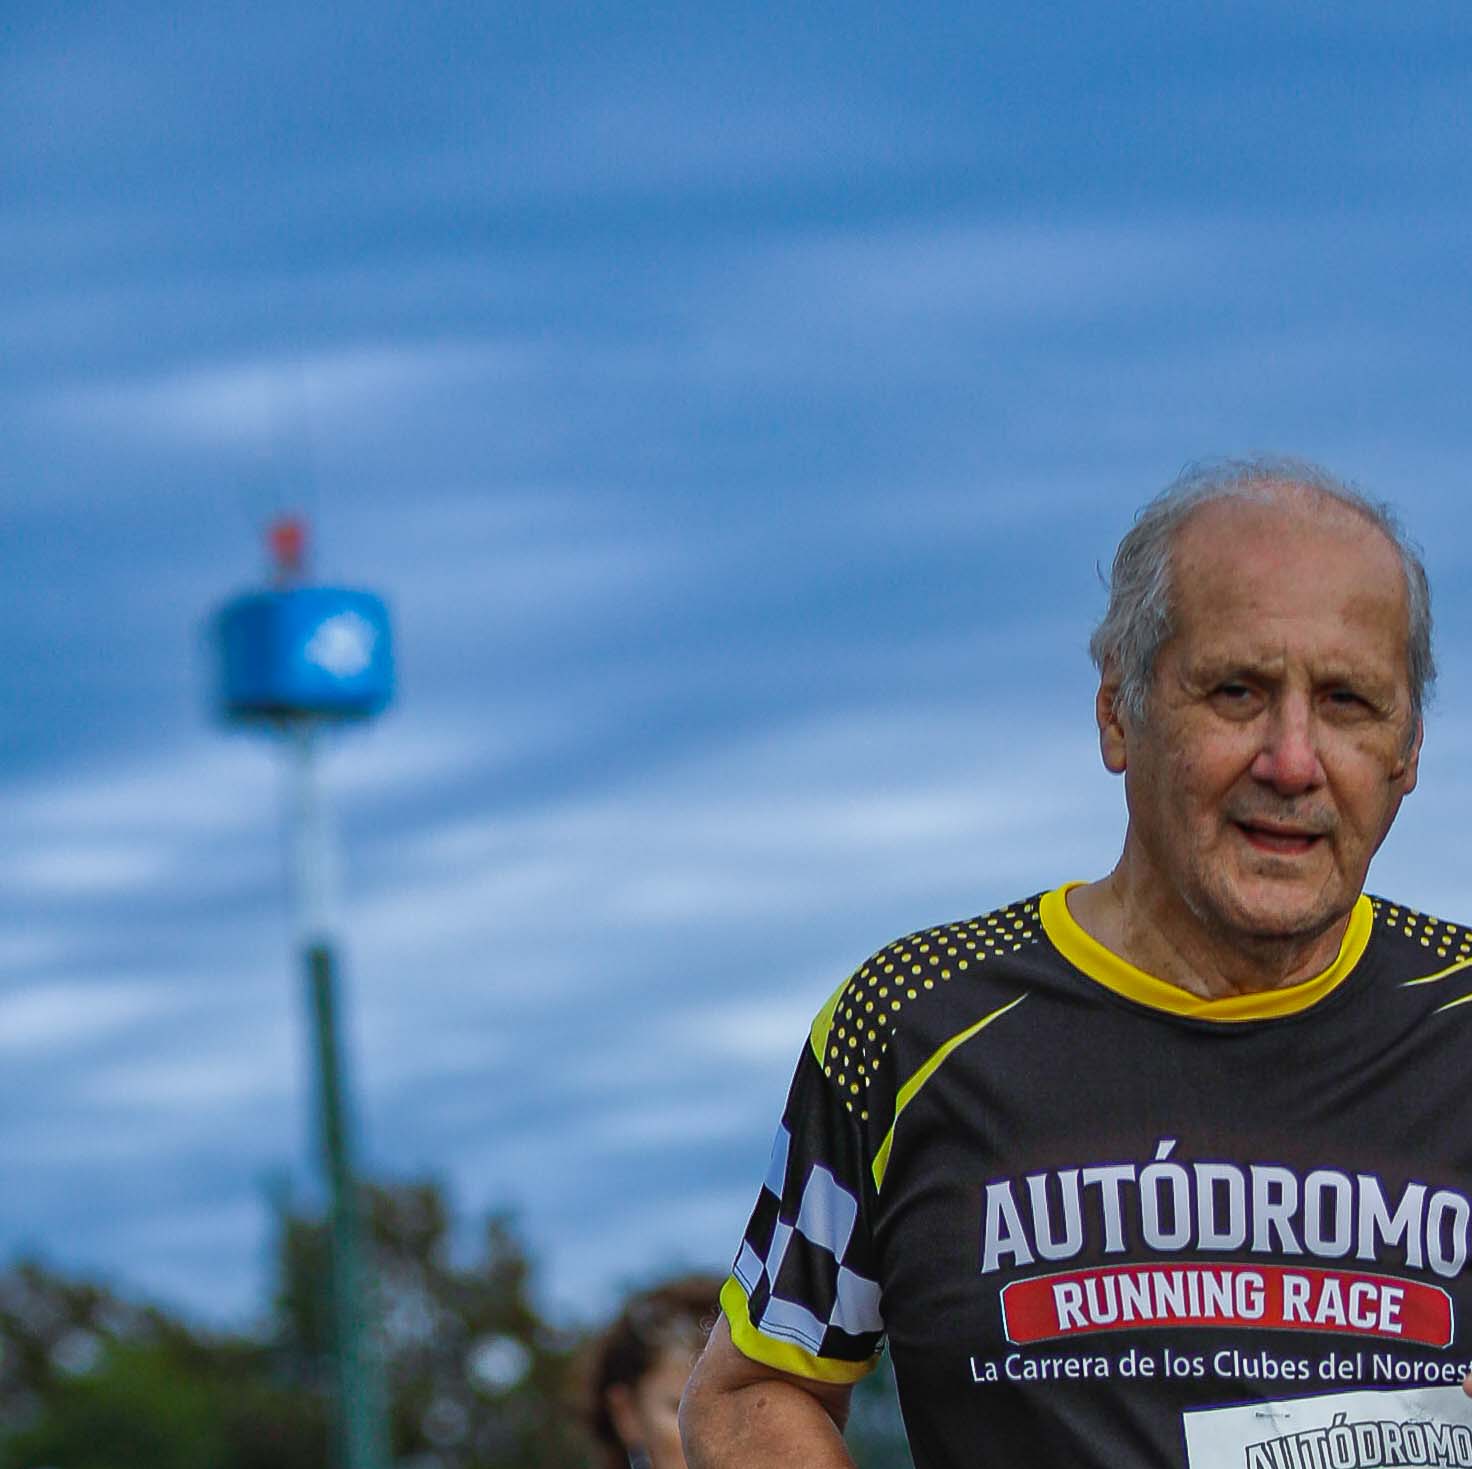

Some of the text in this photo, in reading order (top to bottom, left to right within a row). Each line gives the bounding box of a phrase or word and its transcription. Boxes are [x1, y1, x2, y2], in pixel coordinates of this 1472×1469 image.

[981, 1140, 1470, 1278] AUTÓDROMO
[1052, 1271, 1404, 1333] RUNNING RACE
[970, 1356, 998, 1382] La
[1005, 1353, 1109, 1381] Carrera
[1119, 1349, 1155, 1377] de
[1164, 1349, 1205, 1377] los
[1213, 1350, 1309, 1380] Clubes
[1318, 1352, 1362, 1380] del
